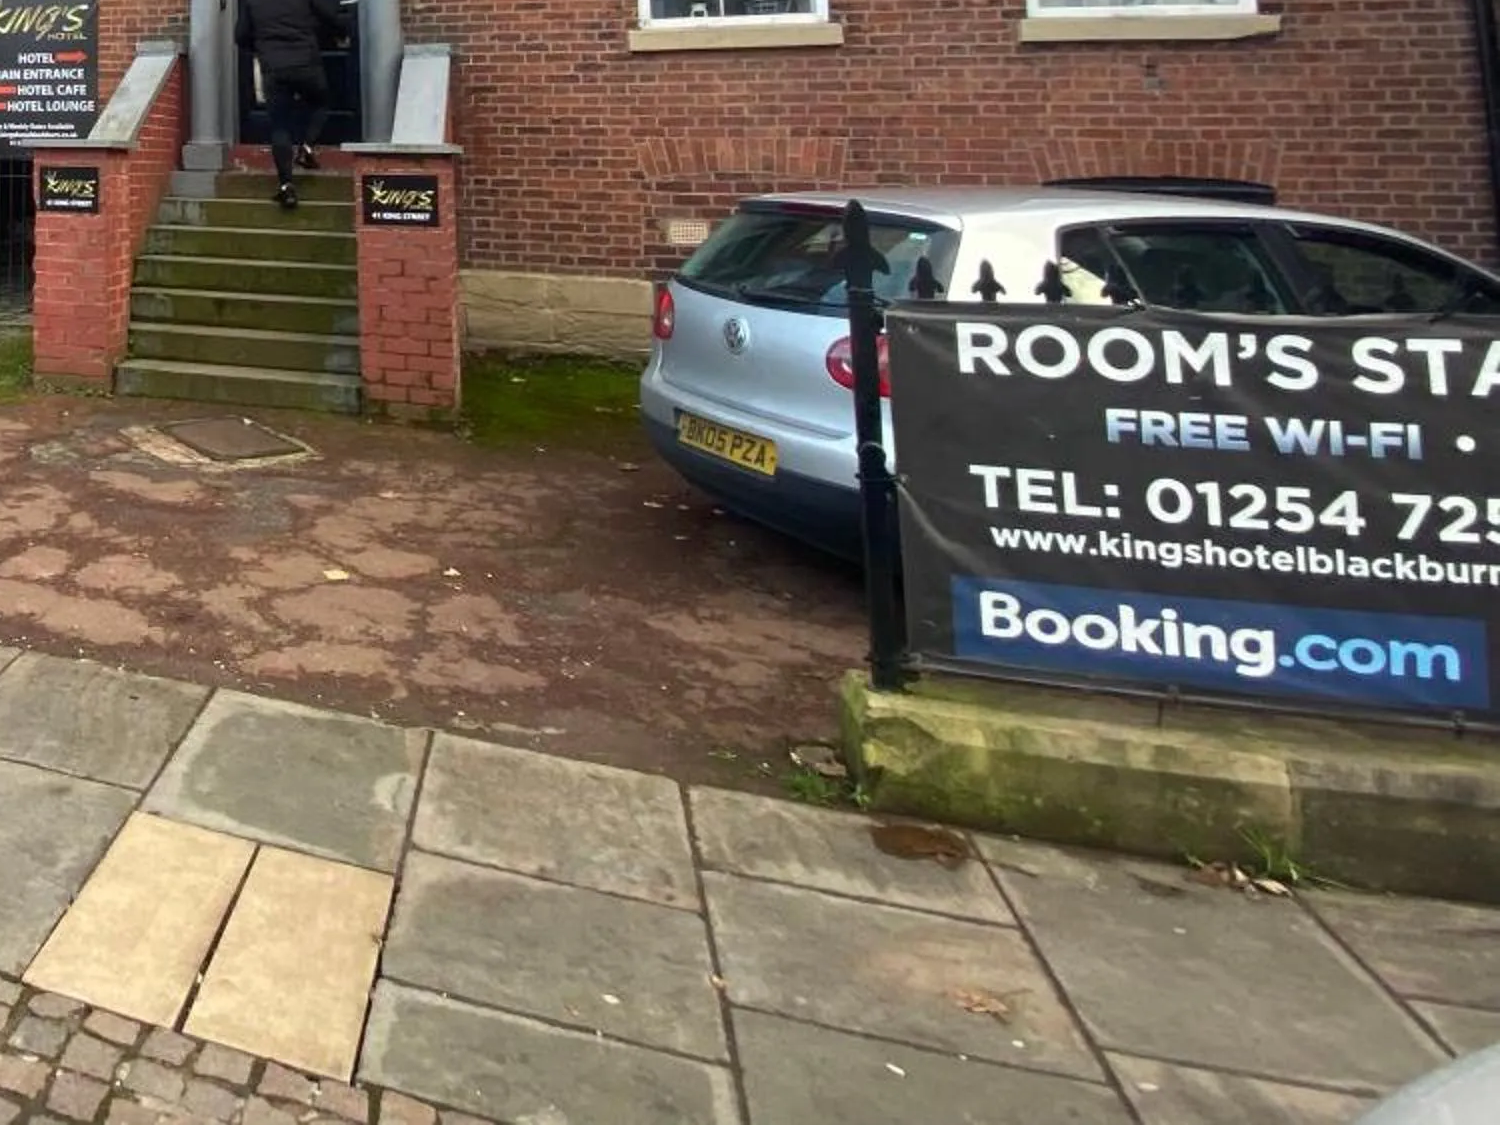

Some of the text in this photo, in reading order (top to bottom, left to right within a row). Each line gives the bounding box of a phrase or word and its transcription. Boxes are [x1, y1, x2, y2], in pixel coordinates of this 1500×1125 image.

[47, 32, 88, 40] HOTEL
[18, 53, 55, 64] HOTEL
[23, 68, 85, 80] ENTRANCE
[17, 84, 87, 95] HOTEL CAFE
[7, 100, 96, 112] HOTEL LOUNGE
[955, 322, 1320, 391] ROOM'S
[1105, 408, 1423, 460] FREE WI-FI
[730, 434, 767, 469] PZA
[968, 464, 1122, 519] TEL:
[1145, 478, 1366, 537] 01254
[980, 591, 1461, 681] Booking.com
